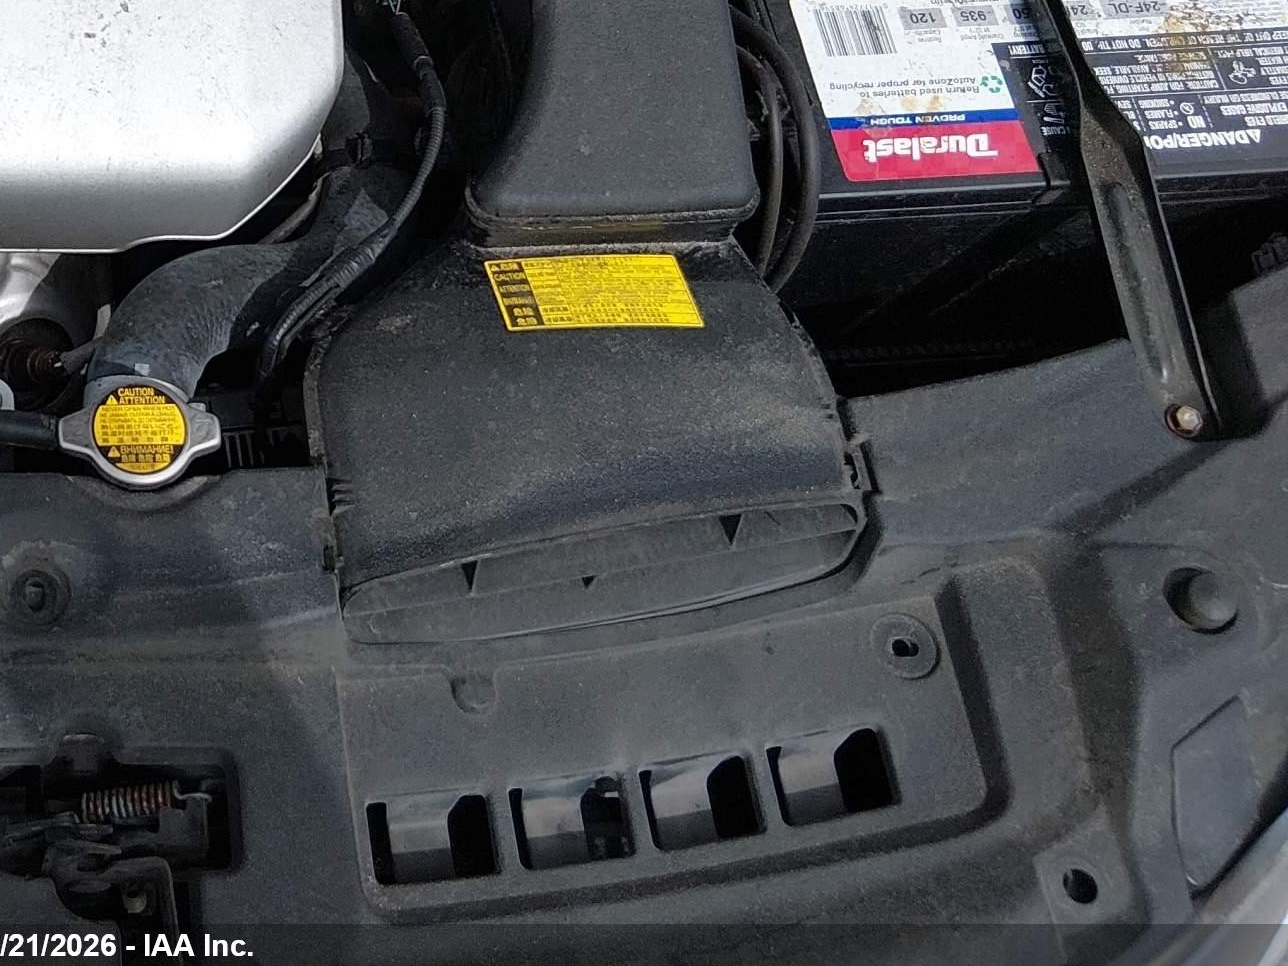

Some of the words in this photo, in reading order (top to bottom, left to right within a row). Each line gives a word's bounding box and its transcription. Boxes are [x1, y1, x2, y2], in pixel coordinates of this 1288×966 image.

[1107, 1, 1161, 14] 24F-DL
[910, 12, 937, 25] 120
[960, 10, 987, 22] 935
[1255, 31, 1271, 41] OUT
[1111, 39, 1129, 49] NOT
[1128, 38, 1141, 49] DO
[1008, 44, 1044, 56] BATTERY!
[876, 78, 909, 88] proper
[928, 77, 976, 86] AutoZone
[1128, 73, 1158, 83] VEHICLE
[830, 81, 874, 91] recycling
[945, 85, 979, 95] Return
[859, 91, 870, 99] to
[872, 89, 916, 98] batteries
[919, 88, 943, 96] used
[915, 113, 966, 123] PROVEN
[1144, 110, 1174, 119] FLAMES
[870, 116, 912, 125] TOUGH
[1148, 120, 1178, 130] SPARKS
[1187, 115, 1207, 129] NO
[1244, 116, 1267, 127] EYES
[1040, 126, 1066, 136] CAUSE
[862, 133, 999, 164] Duralast
[493, 272, 526, 282] CAUTION
[118, 388, 154, 396] CAUTION
[119, 396, 165, 404] ATTENTION
